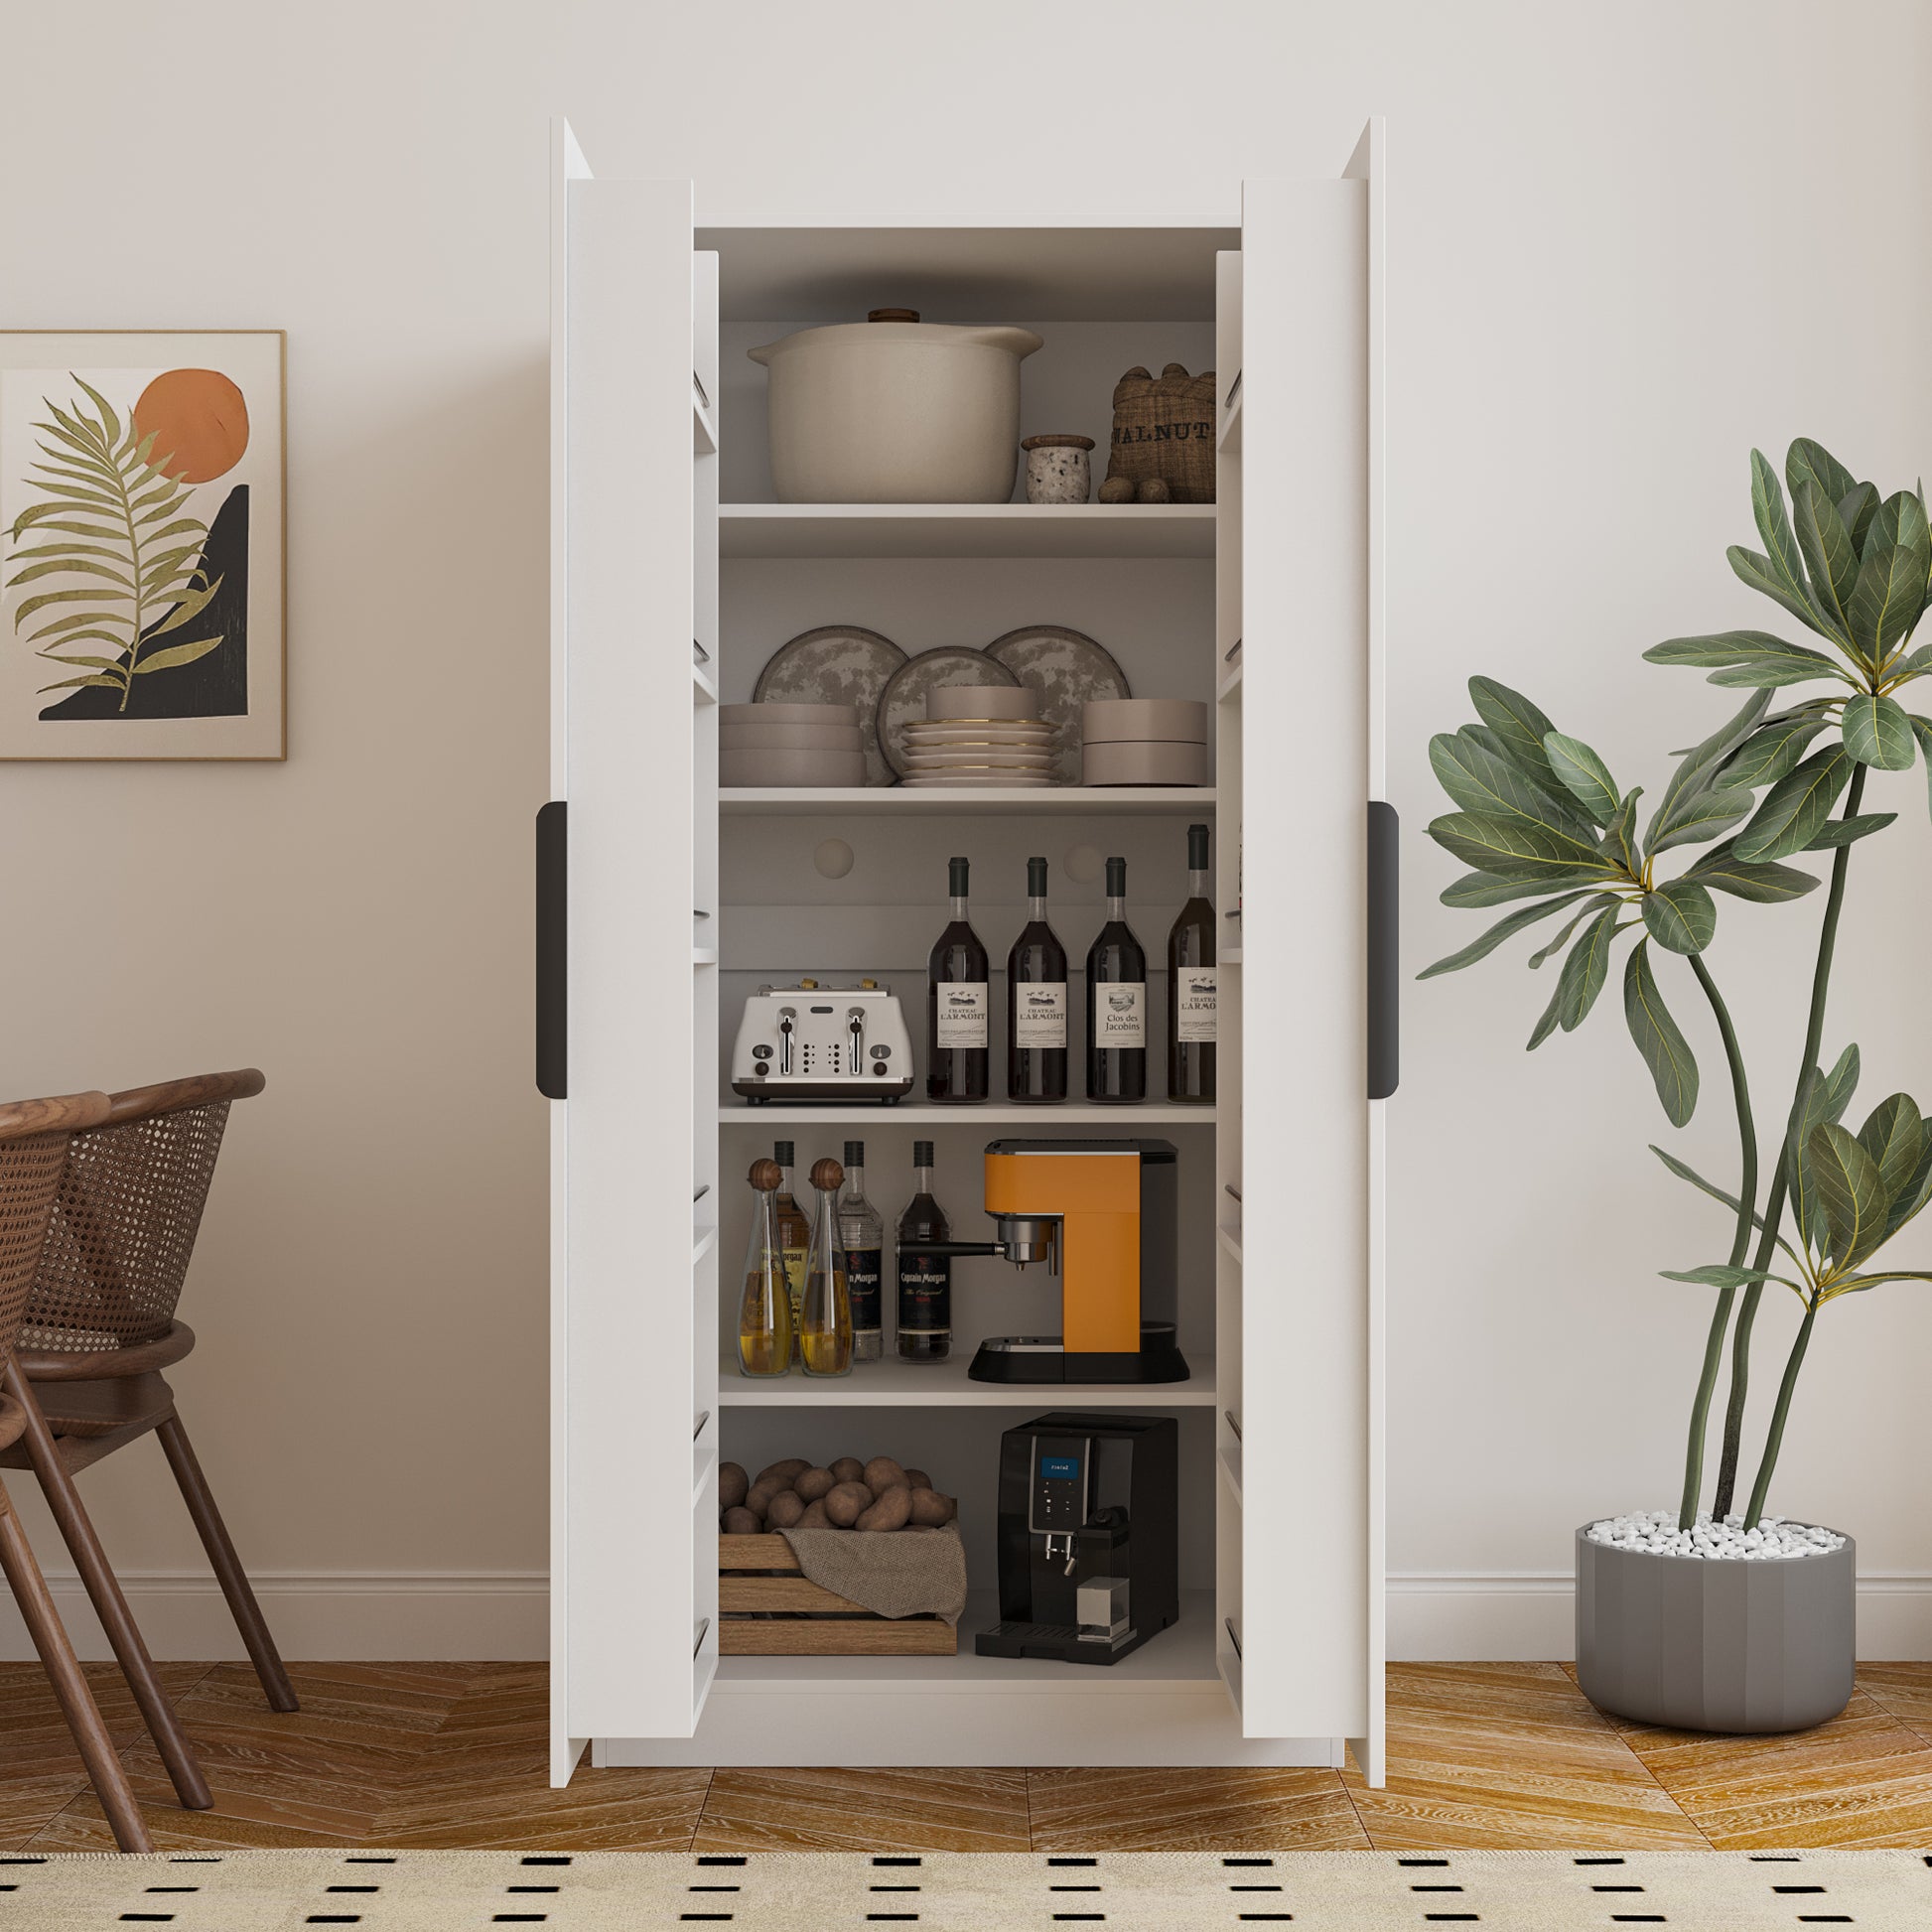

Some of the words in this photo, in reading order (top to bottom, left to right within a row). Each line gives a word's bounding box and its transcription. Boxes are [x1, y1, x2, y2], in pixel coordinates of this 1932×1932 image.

[1105, 1022, 1140, 1032] Jacobins
[782, 1252, 802, 1262] organ
[854, 1273, 878, 1284] Morgan
[900, 1272, 921, 1284] Captain
[922, 1273, 946, 1284] Morgan
